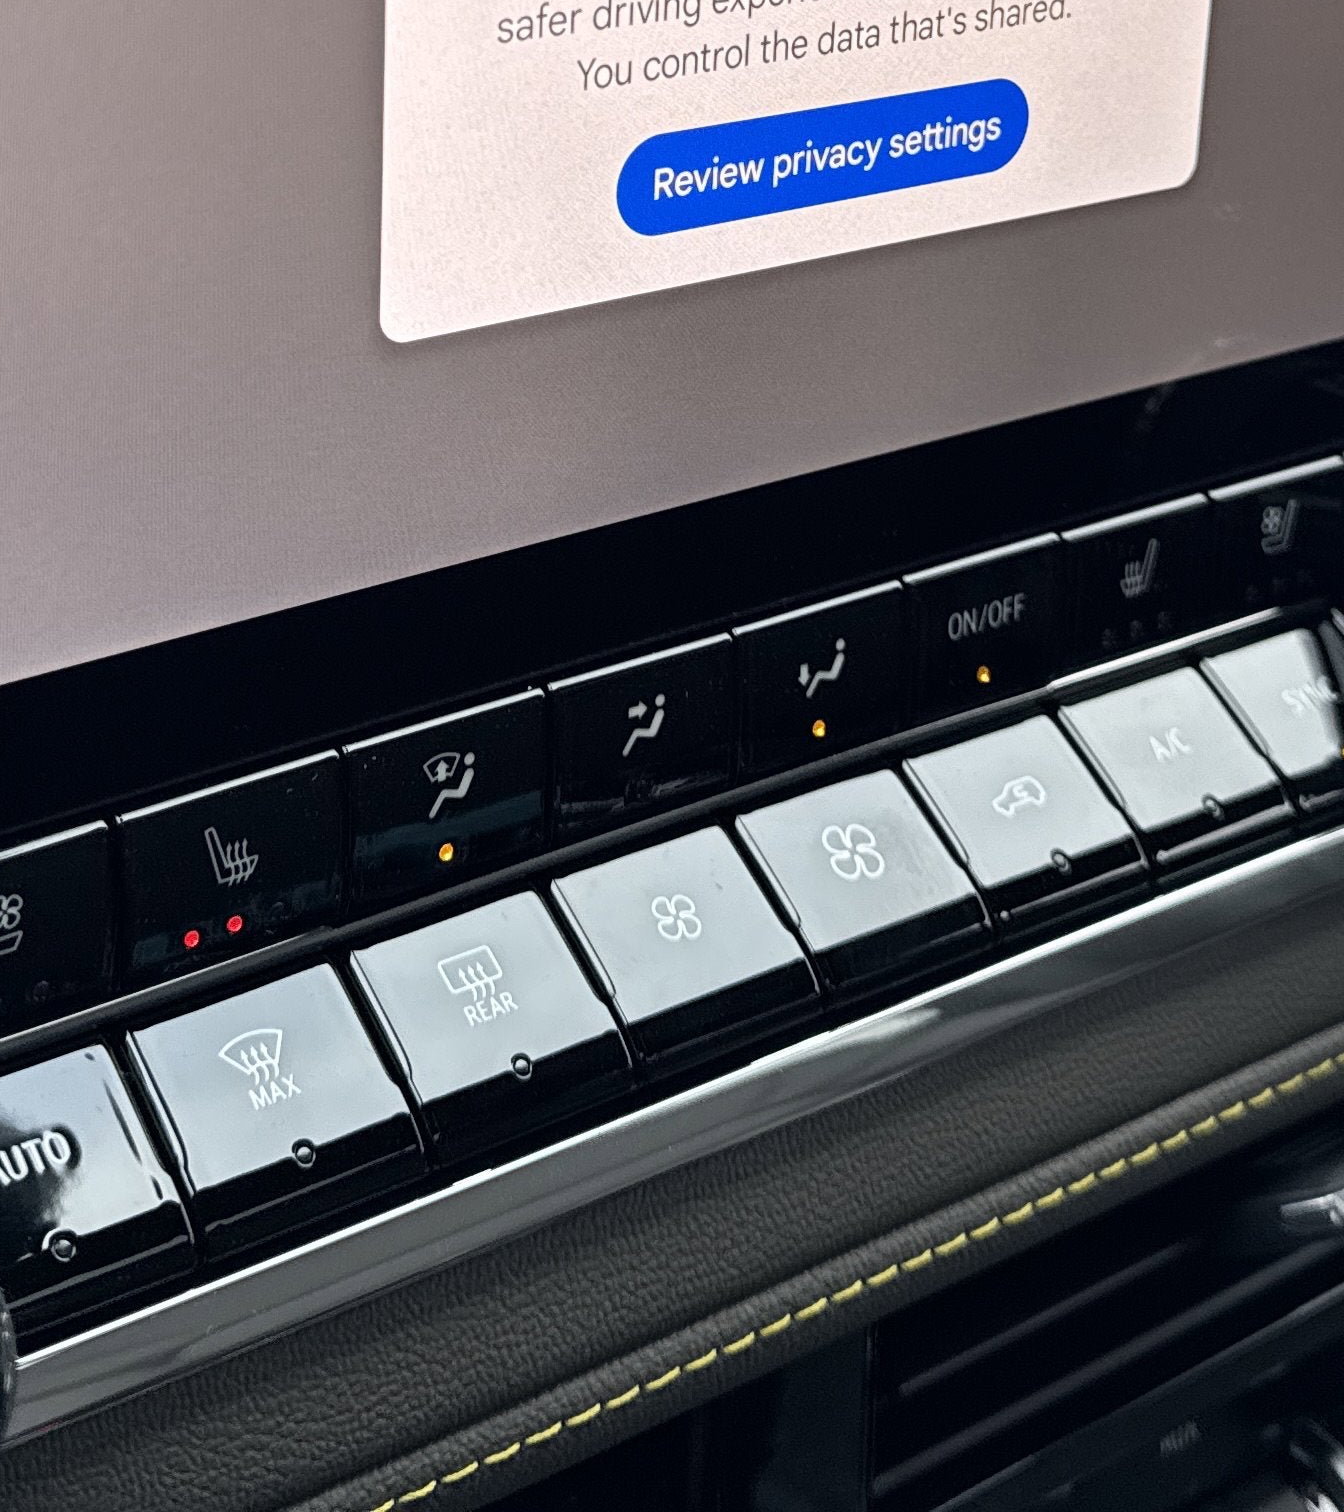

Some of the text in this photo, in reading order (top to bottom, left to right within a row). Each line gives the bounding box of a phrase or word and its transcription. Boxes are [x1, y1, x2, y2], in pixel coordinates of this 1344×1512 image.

[497, 1, 584, 45] safer
[576, 57, 633, 91] You
[643, 33, 751, 83] control
[760, 29, 808, 68] the
[817, 20, 881, 57] data
[889, 8, 967, 46] that's
[653, 116, 1002, 201] Review privacy settings
[947, 591, 1026, 642] ON/OFF
[1148, 726, 1191, 763] A/C
[463, 990, 519, 1027] REAR
[248, 1073, 302, 1111] MAX
